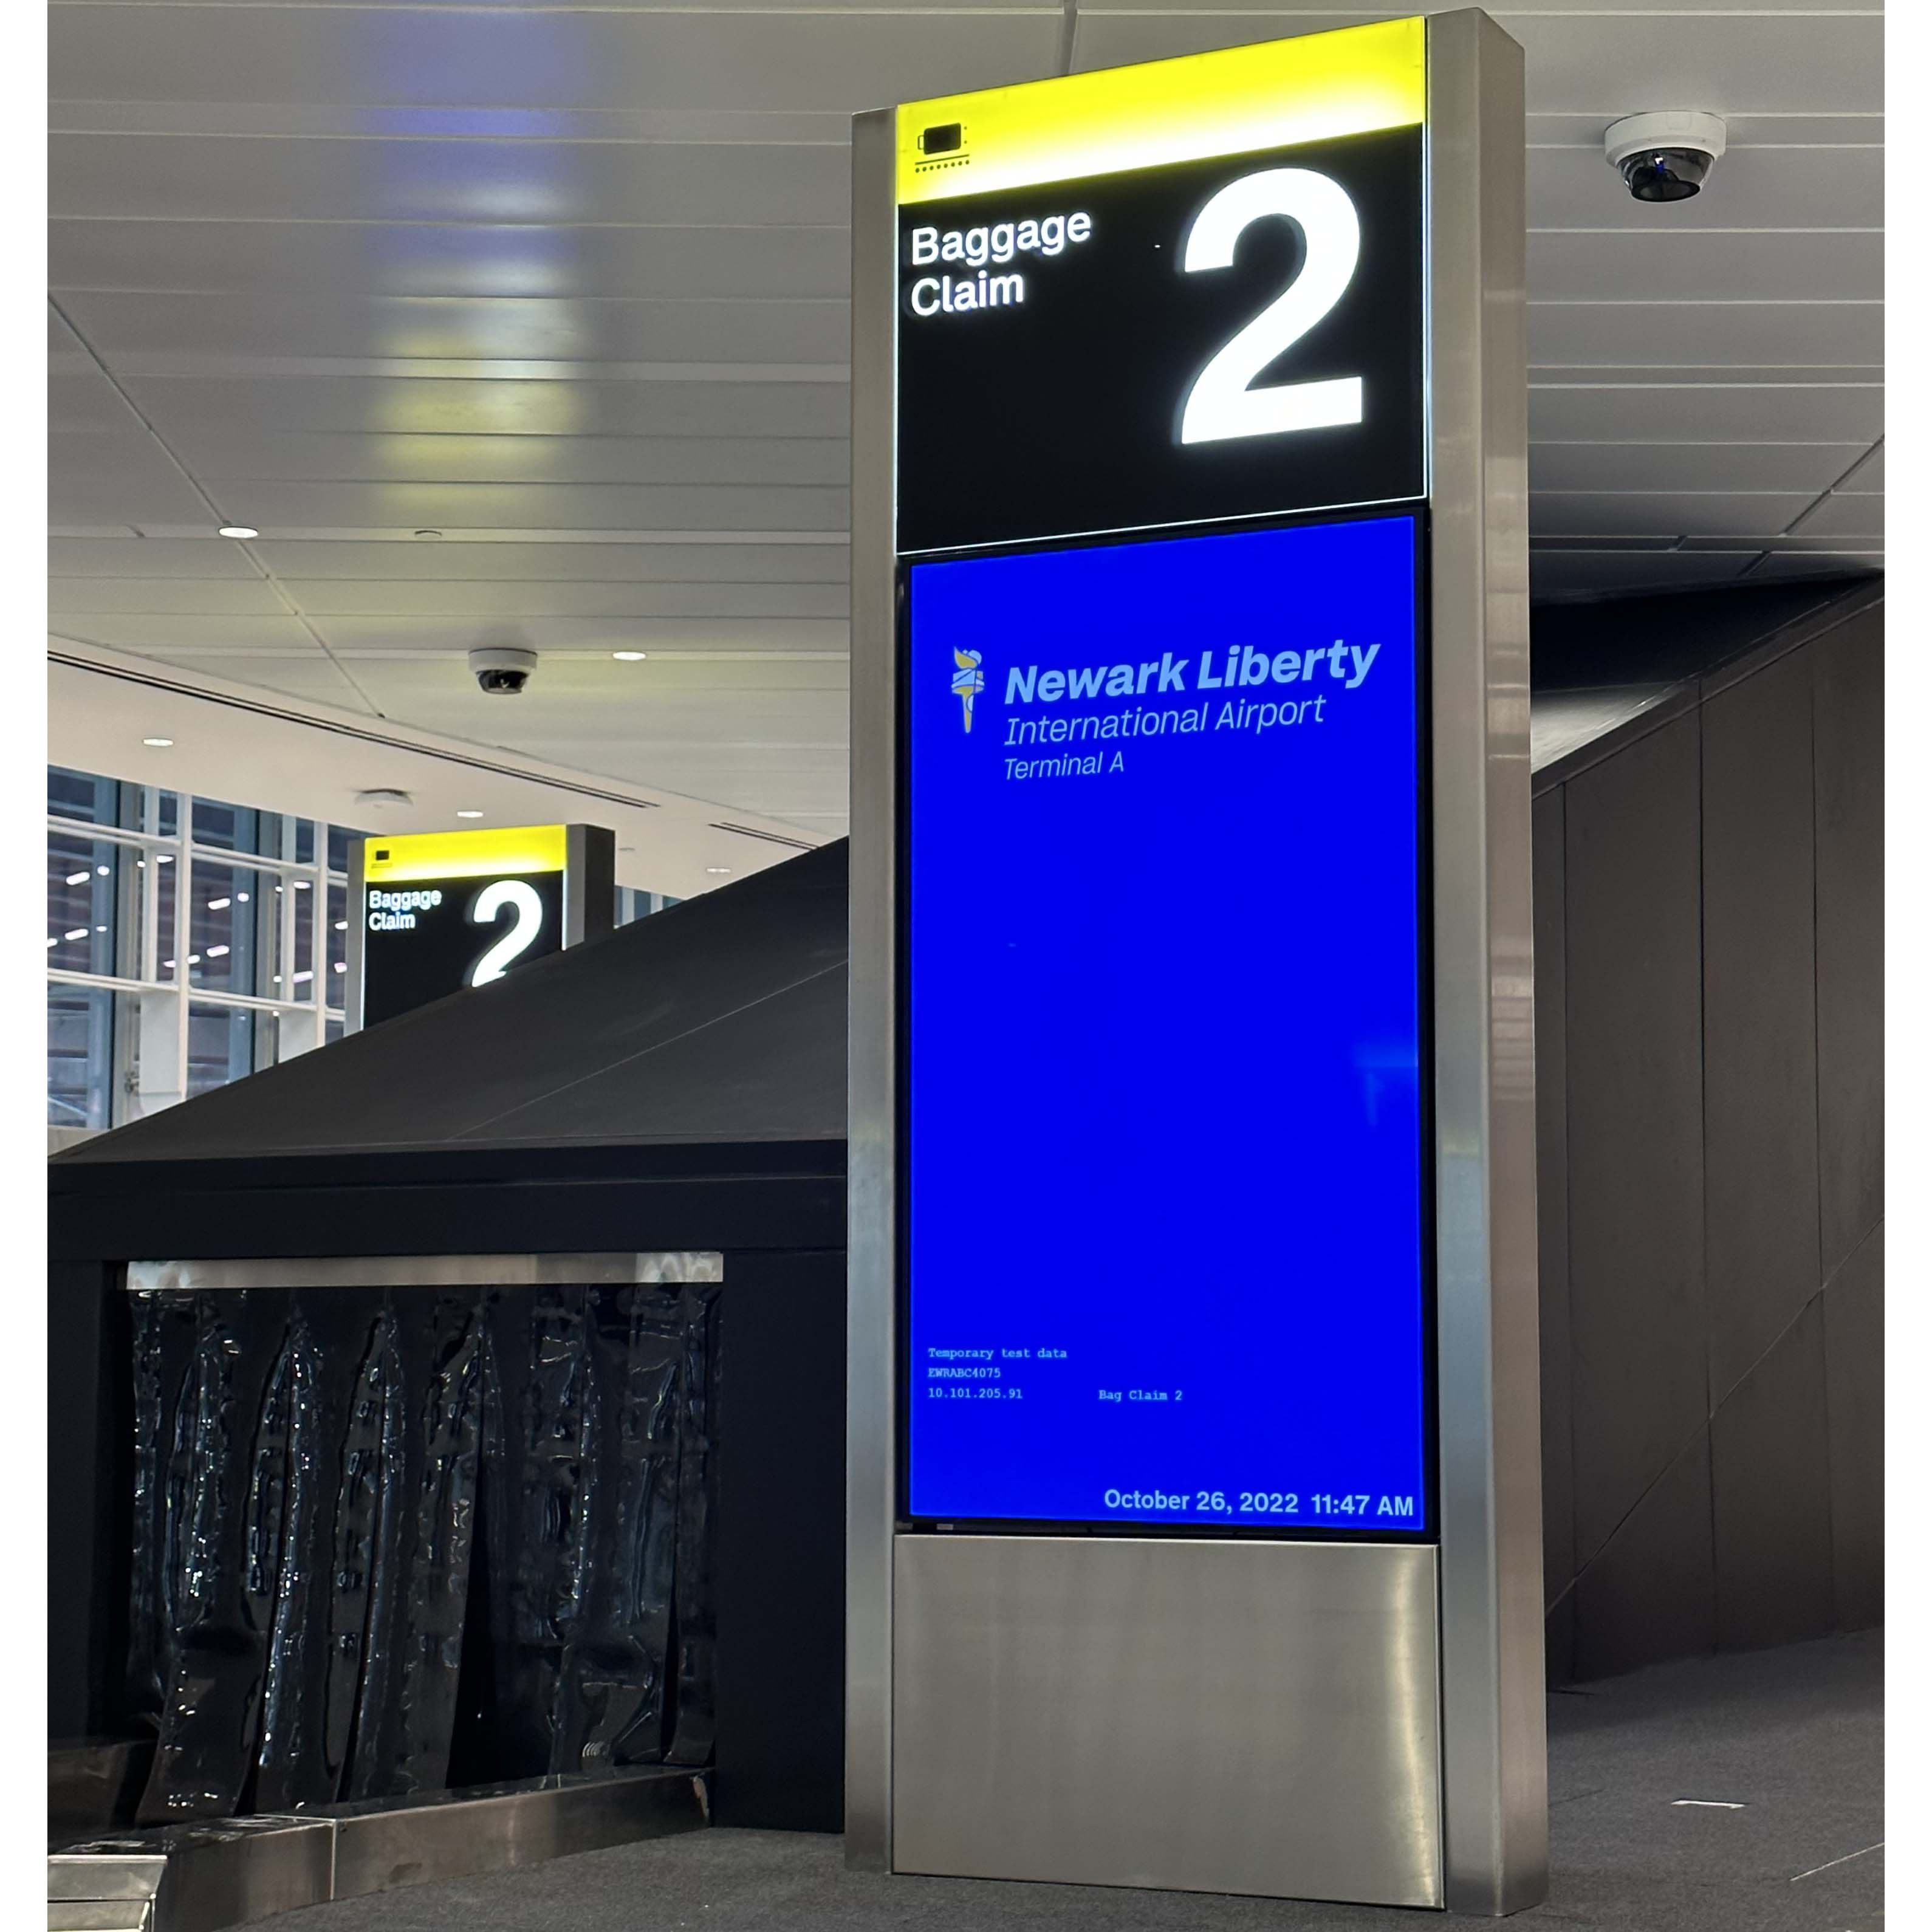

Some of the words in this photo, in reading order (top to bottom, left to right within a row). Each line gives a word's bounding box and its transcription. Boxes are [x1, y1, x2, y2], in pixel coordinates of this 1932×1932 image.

[912, 211, 1091, 267] Baggage
[911, 270, 1024, 316] Claim
[1181, 168, 1363, 445] 2
[1004, 653, 1188, 704] Newark
[1197, 639, 1381, 689] Liberty
[1004, 702, 1209, 745] International
[1214, 694, 1326, 734] Airport
[1004, 751, 1103, 779] Terminal
[1109, 751, 1124, 773] A
[369, 889, 442, 910] Baggage
[369, 911, 416, 931] Claim
[473, 880, 543, 987] 2
[928, 1347, 994, 1360] Temporary
[1001, 1348, 1031, 1358] test
[1037, 1348, 1068, 1358] data
[928, 1367, 1001, 1379] EWRABC4075
[928, 1387, 1023, 1399] 10.101.205.91
[1098, 1389, 1122, 1403] Bag
[1128, 1389, 1168, 1401] Claim
[1175, 1389, 1183, 1401] 2
[1104, 1488, 1190, 1510] October
[1196, 1491, 1233, 1515] 26,
[1239, 1492, 1299, 1513] 2022
[1310, 1493, 1371, 1515] 11:47
[1377, 1495, 1414, 1516] AM
